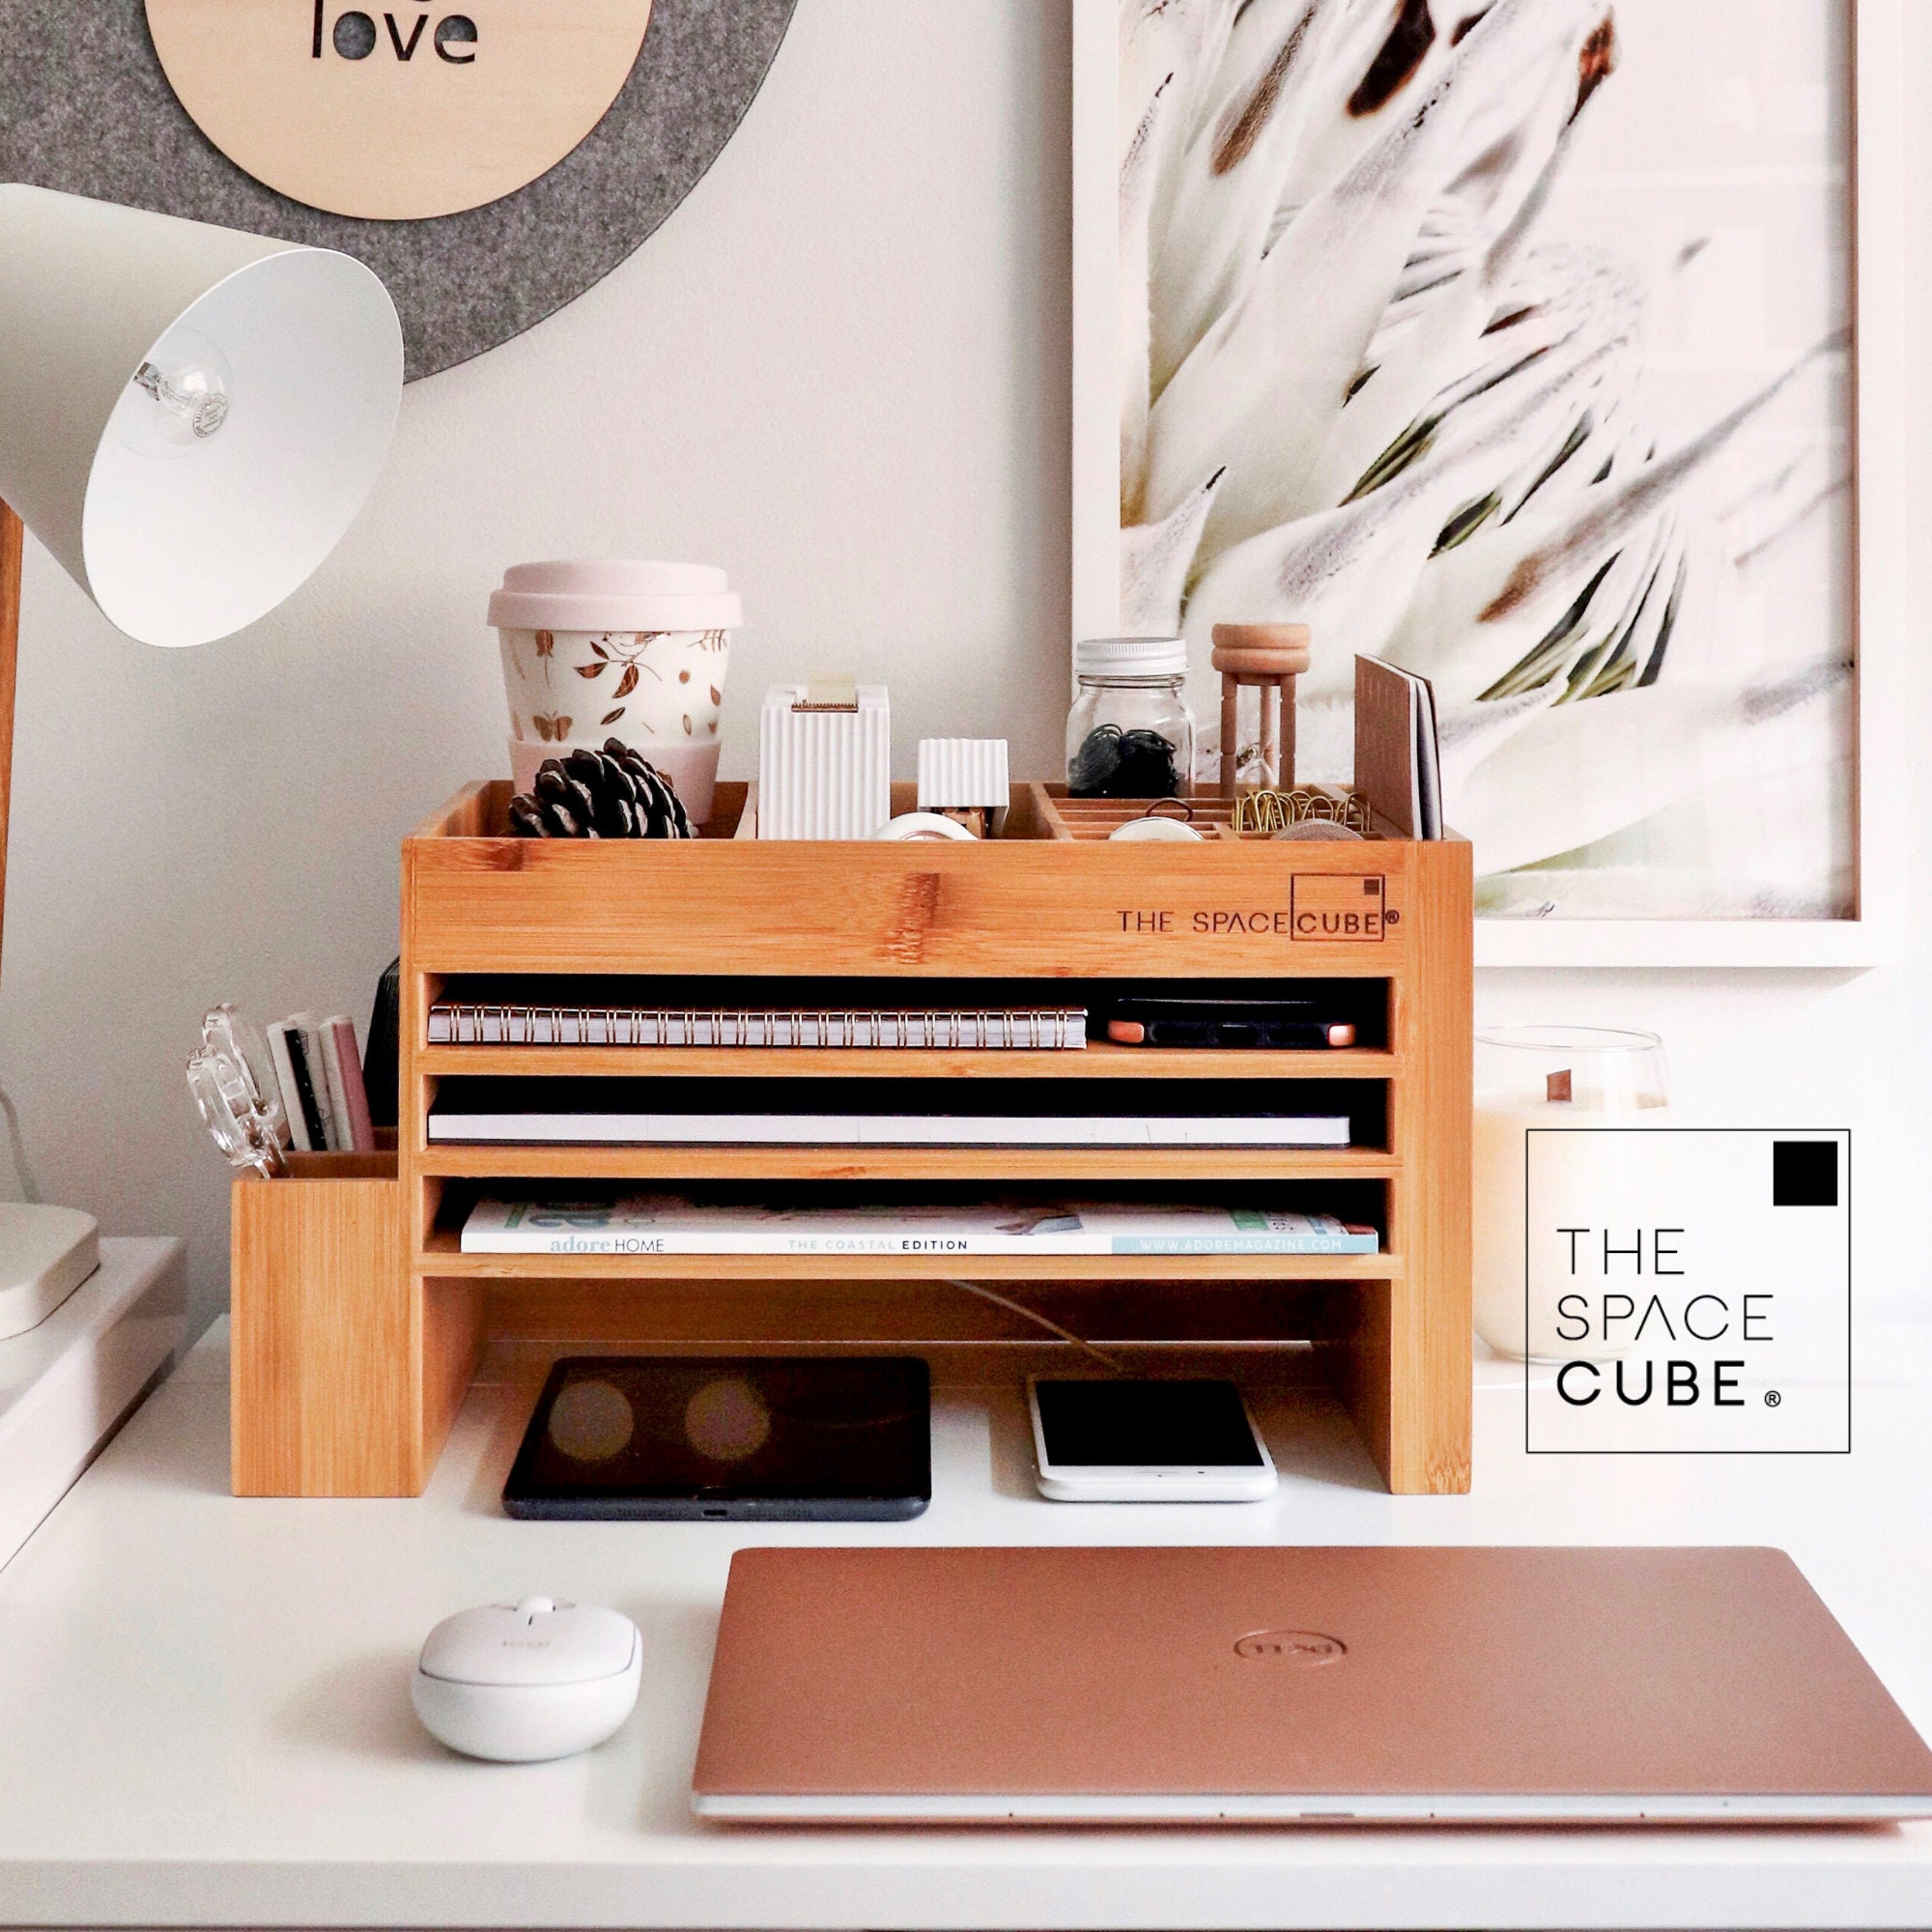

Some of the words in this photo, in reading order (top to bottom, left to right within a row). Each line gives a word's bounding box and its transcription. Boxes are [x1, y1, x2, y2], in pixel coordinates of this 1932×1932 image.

[312, 0, 478, 64] love
[1117, 910, 1176, 933] THE
[1192, 911, 1289, 934] SPACE
[1296, 912, 1379, 935] CUBE
[550, 1236, 611, 1253] adore
[614, 1238, 665, 1253] HOME
[788, 1239, 818, 1251] THE
[825, 1239, 896, 1251] COASTAL
[901, 1240, 968, 1251] EDITION
[1139, 1238, 1343, 1251] WWW.ADOREMAGAZINE.COM
